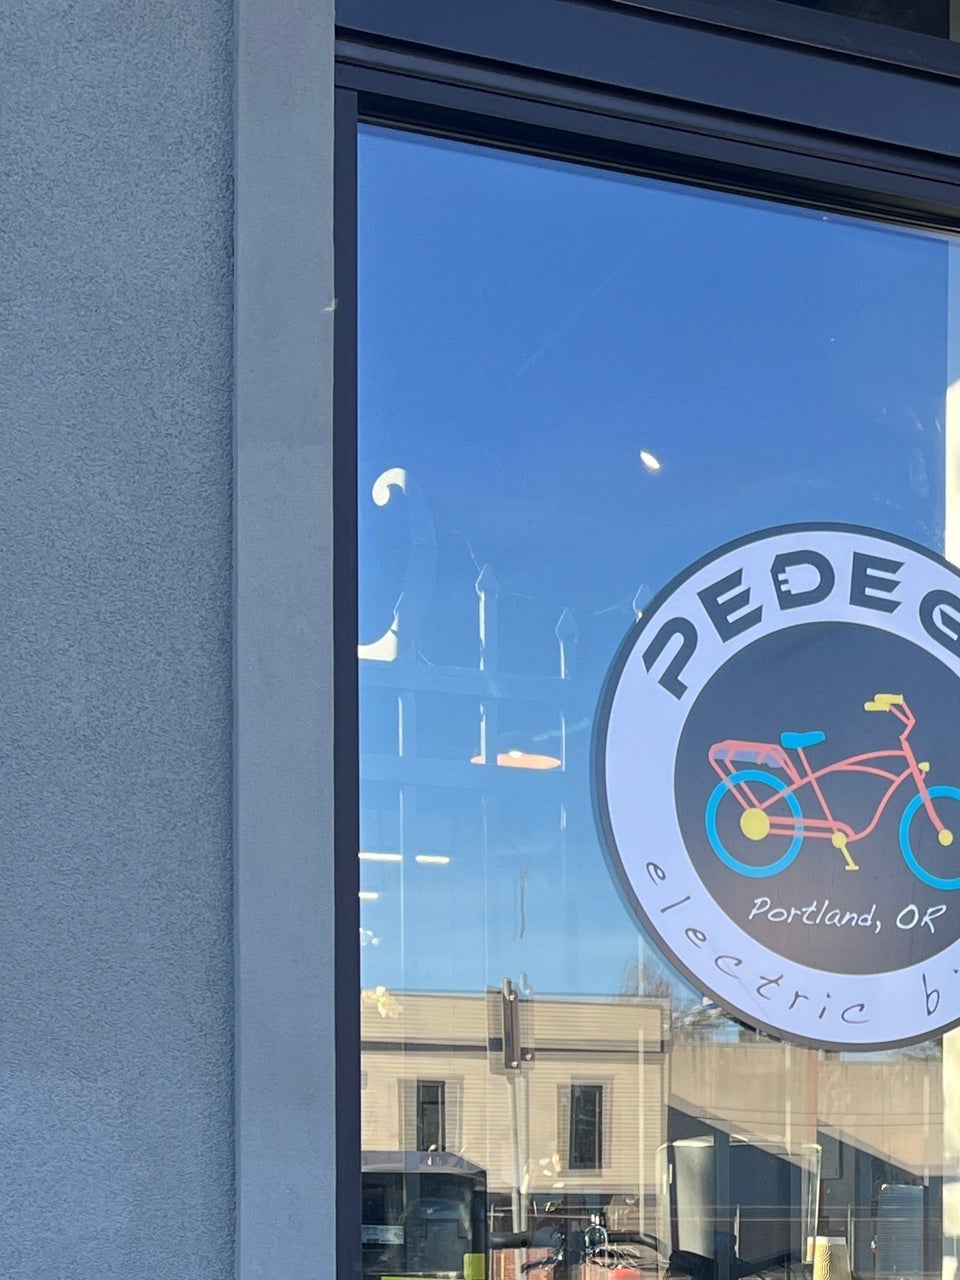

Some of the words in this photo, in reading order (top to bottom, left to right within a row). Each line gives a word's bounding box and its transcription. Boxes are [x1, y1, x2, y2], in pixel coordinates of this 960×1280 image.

[646, 861, 870, 1024] electric
[748, 897, 882, 933] Portland,
[896, 904, 947, 934] OR
